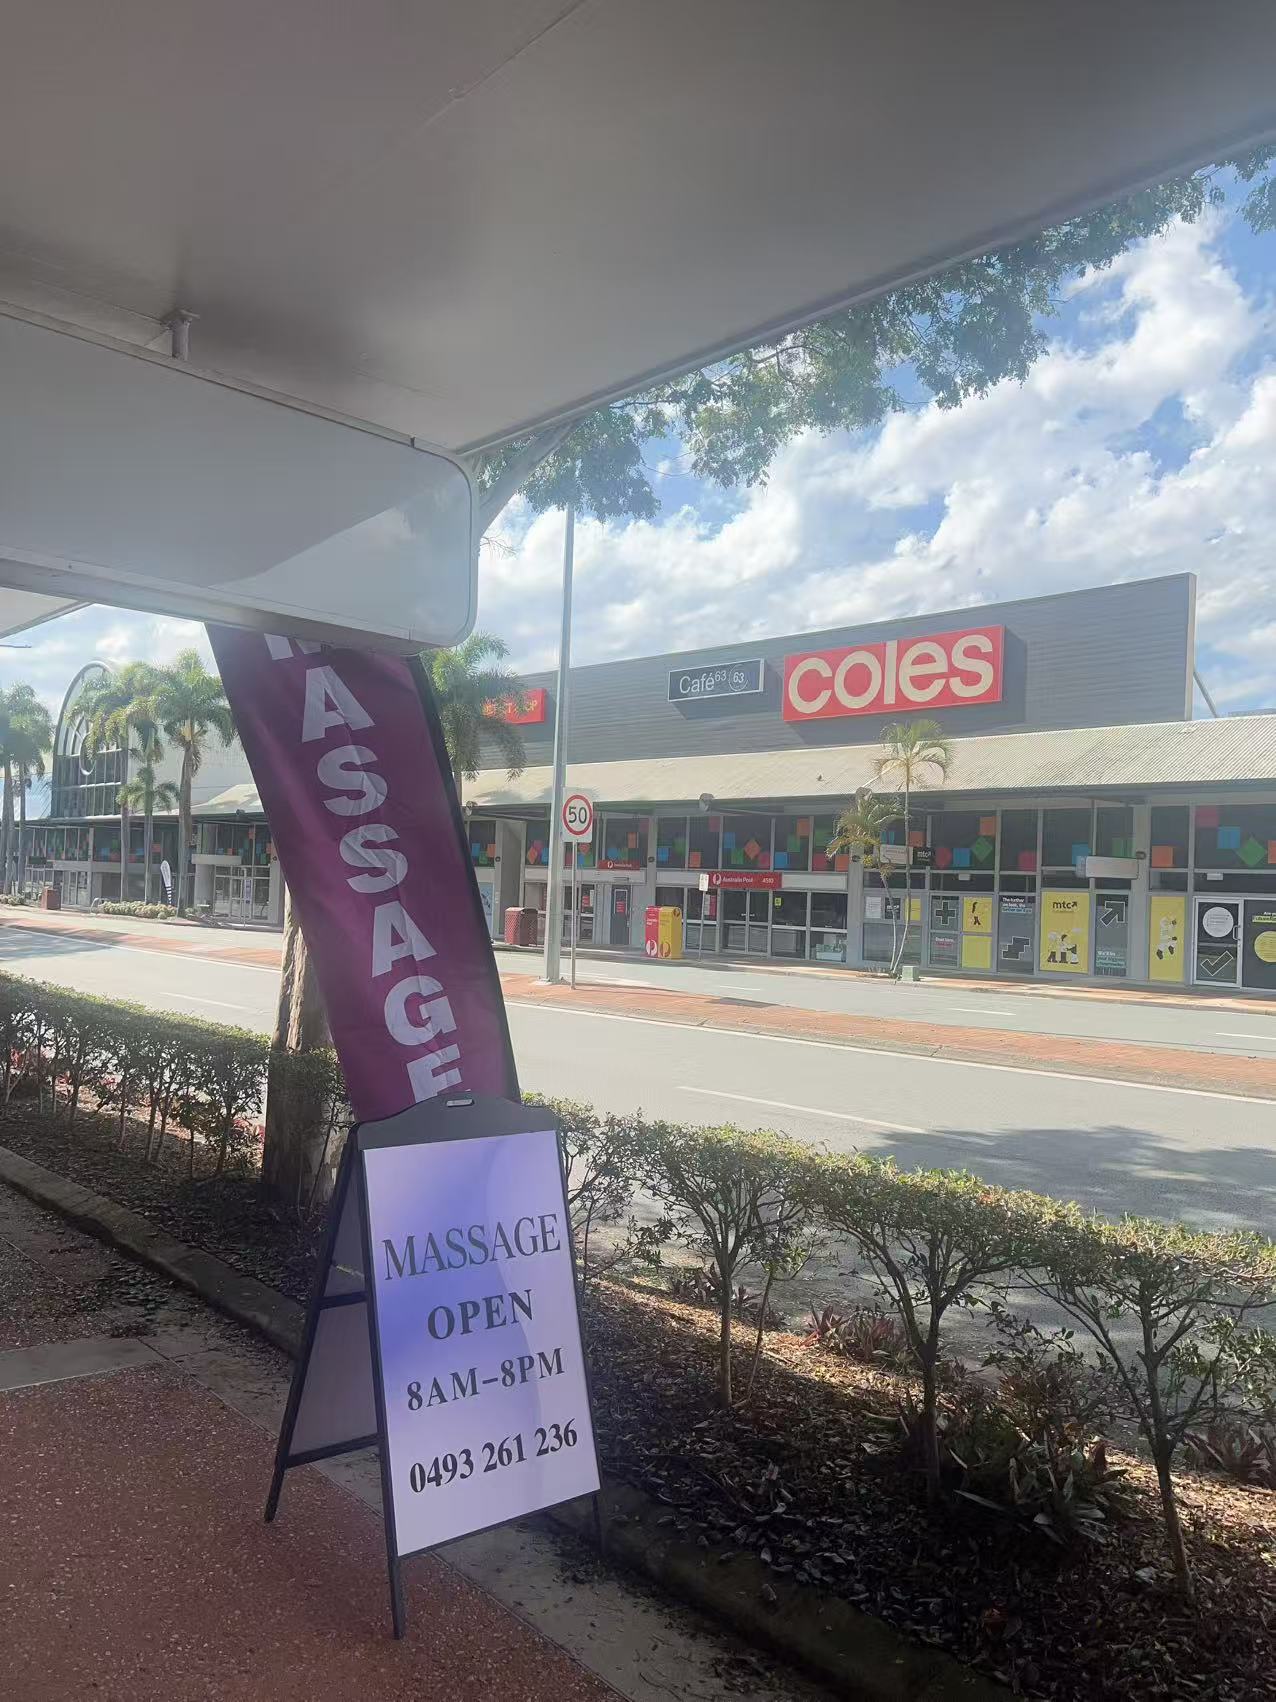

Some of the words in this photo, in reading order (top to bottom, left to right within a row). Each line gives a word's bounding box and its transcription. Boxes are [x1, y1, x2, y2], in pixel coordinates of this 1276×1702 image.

[733, 671, 745, 684] 63
[788, 634, 994, 714] coles
[568, 806, 588, 824] 50
[1052, 901, 1072, 909] mtc
[382, 1213, 561, 1281] MASSAGE
[427, 1289, 533, 1340] OPEN
[409, 1448, 474, 1493] 0493
[481, 1433, 527, 1473] 261
[534, 1418, 577, 1457] 236
